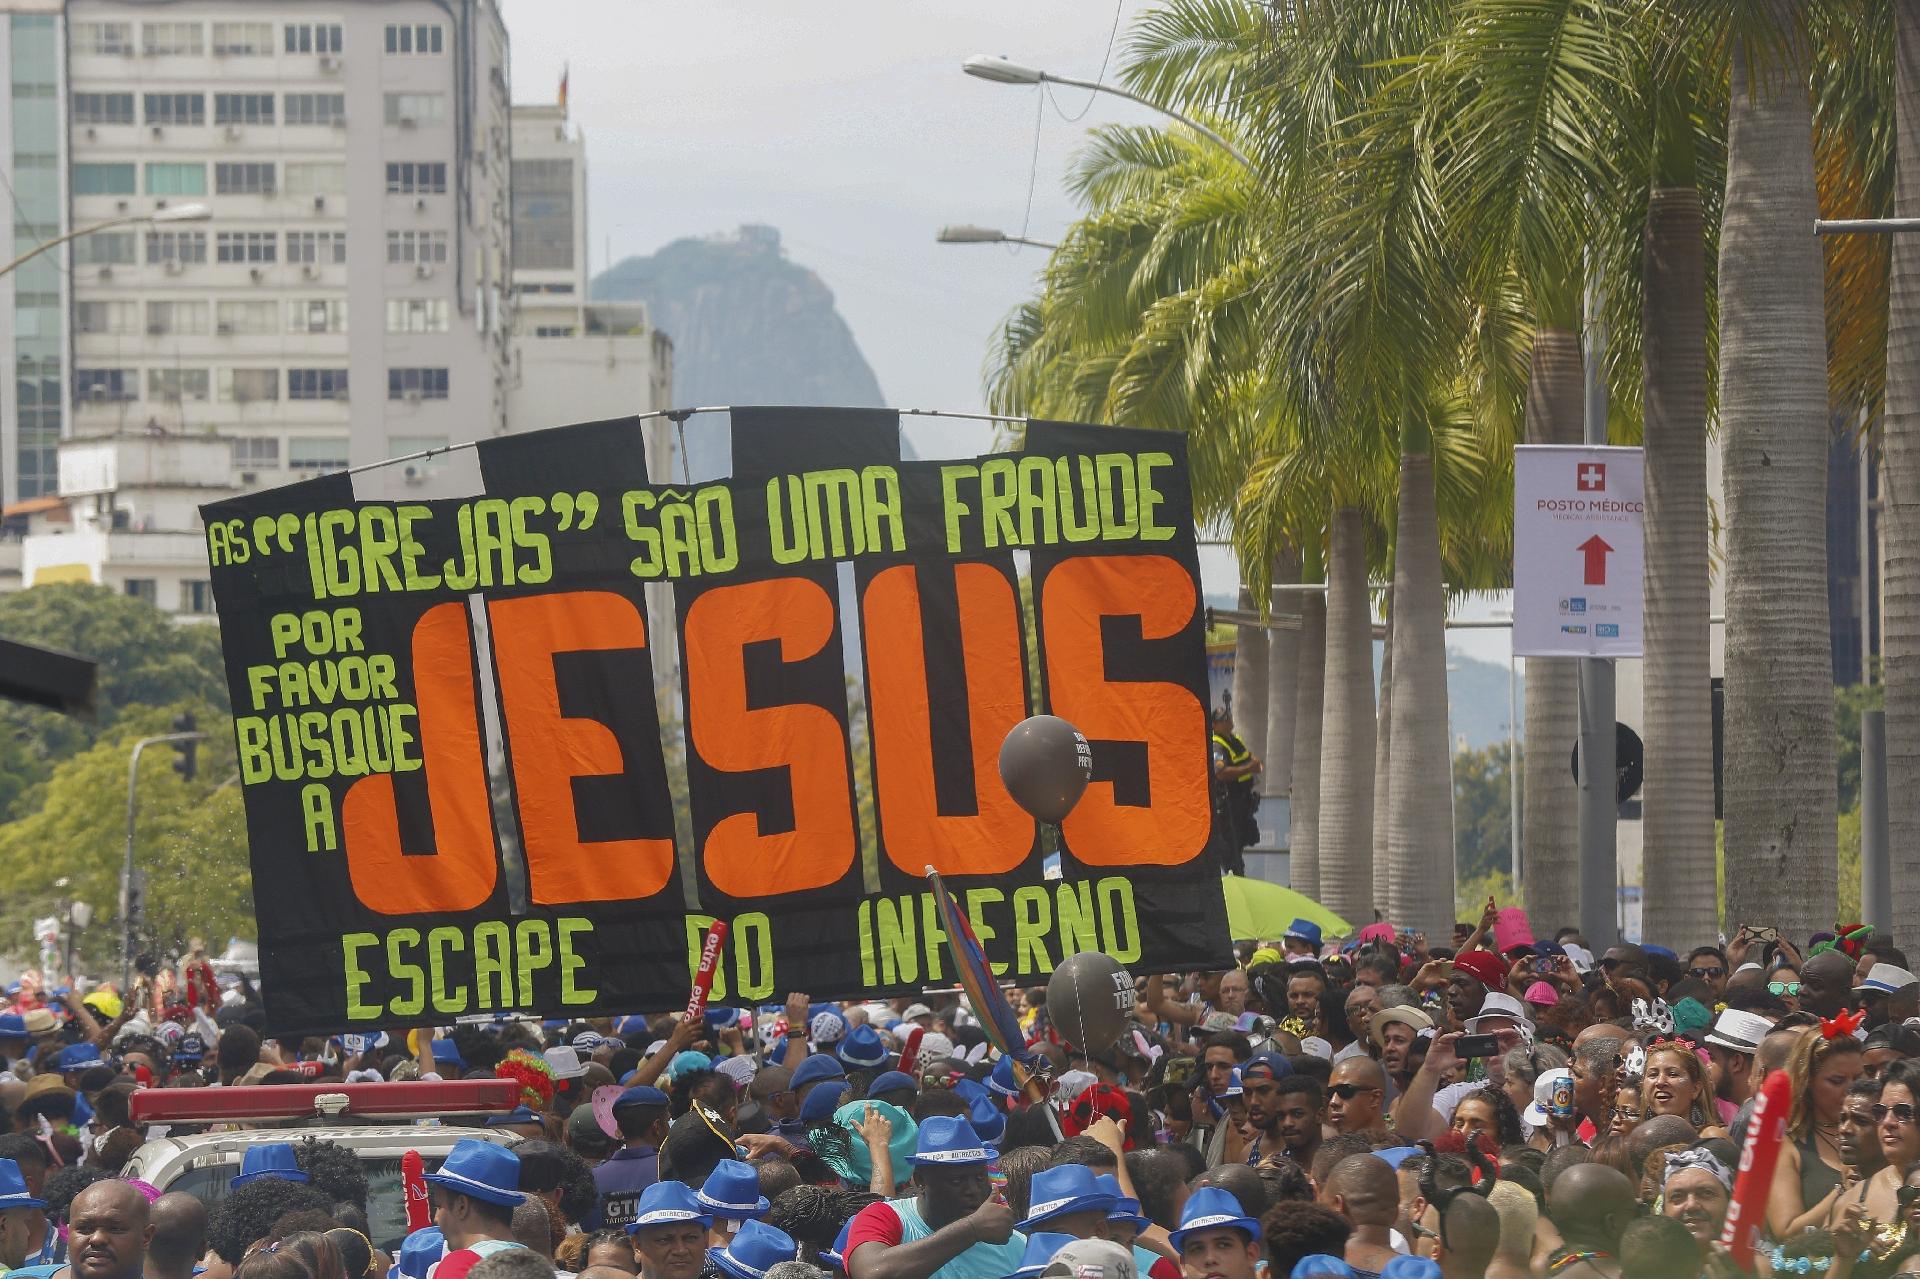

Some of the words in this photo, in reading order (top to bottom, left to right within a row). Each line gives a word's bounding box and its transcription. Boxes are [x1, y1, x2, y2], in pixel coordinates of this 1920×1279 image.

[209, 519, 250, 566] AS
[622, 484, 740, 577] SÃO
[767, 465, 906, 565] UMA
[941, 452, 1177, 553] FRAUDE
[1537, 499, 1586, 512] POSTO
[1590, 497, 1644, 513] MÉDICO
[271, 608, 364, 659] POR
[248, 654, 398, 711] FAVOR
[237, 704, 423, 785] BUSQUE
[344, 556, 1211, 915] JESUS
[302, 784, 337, 852] A
[343, 918, 597, 1020] ESCAPE
[686, 912, 774, 1002] DO
[699, 932, 720, 972] extra
